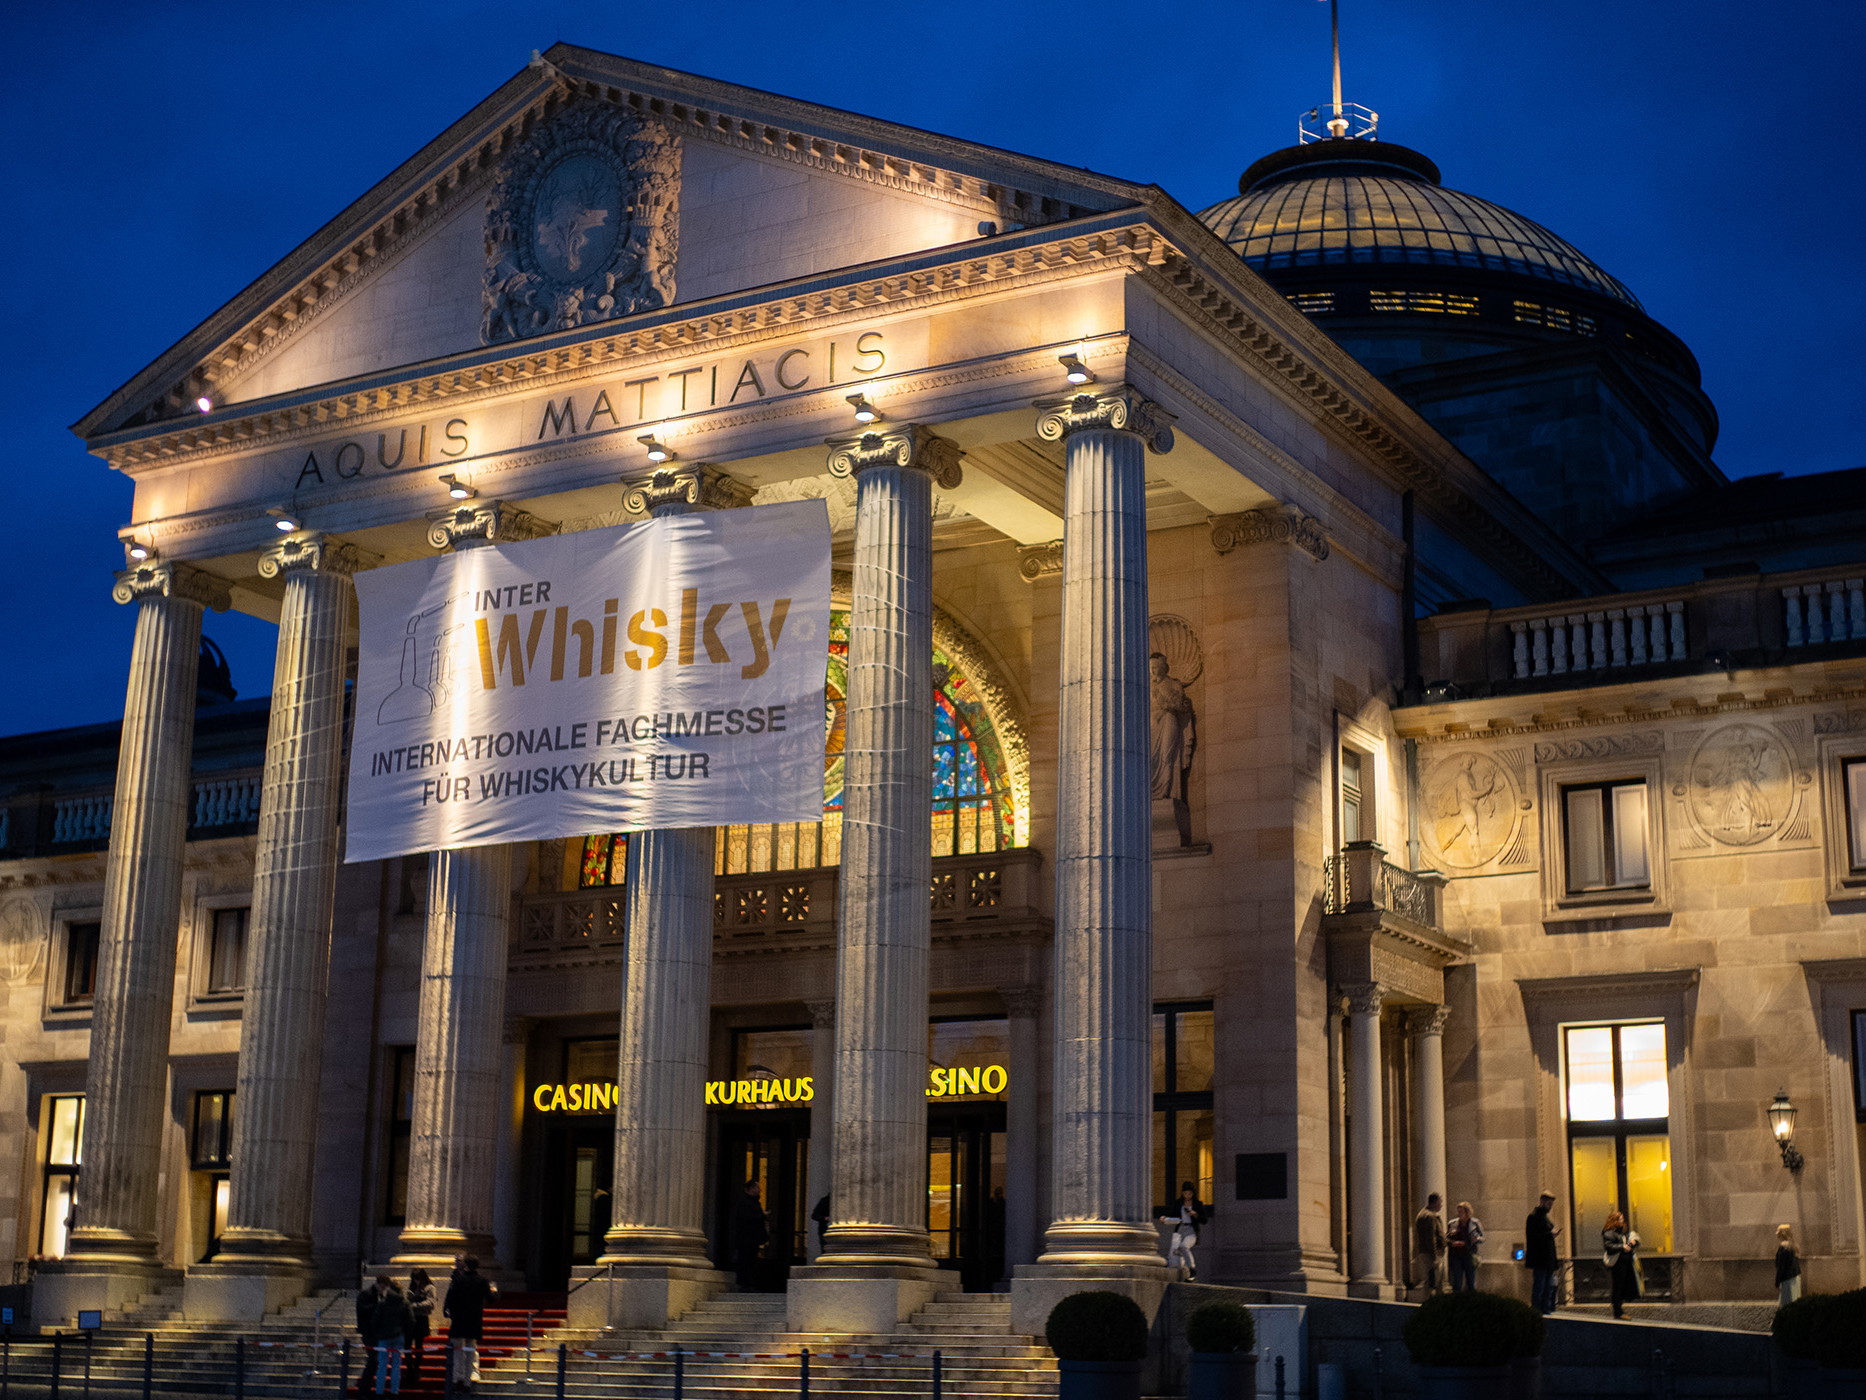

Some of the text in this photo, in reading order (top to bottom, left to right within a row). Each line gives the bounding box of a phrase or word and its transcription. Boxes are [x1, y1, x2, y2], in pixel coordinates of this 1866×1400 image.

[294, 331, 887, 490] AQUIS MATTIACIS
[475, 581, 551, 611] INTER
[474, 588, 792, 690] Whisky
[371, 705, 787, 777] INTERNATIONALE FACHMESSE
[423, 752, 710, 806] FÜR WHISKYKULTUR
[705, 1076, 815, 1105] KURHAUS
[925, 1064, 1008, 1097] SINO
